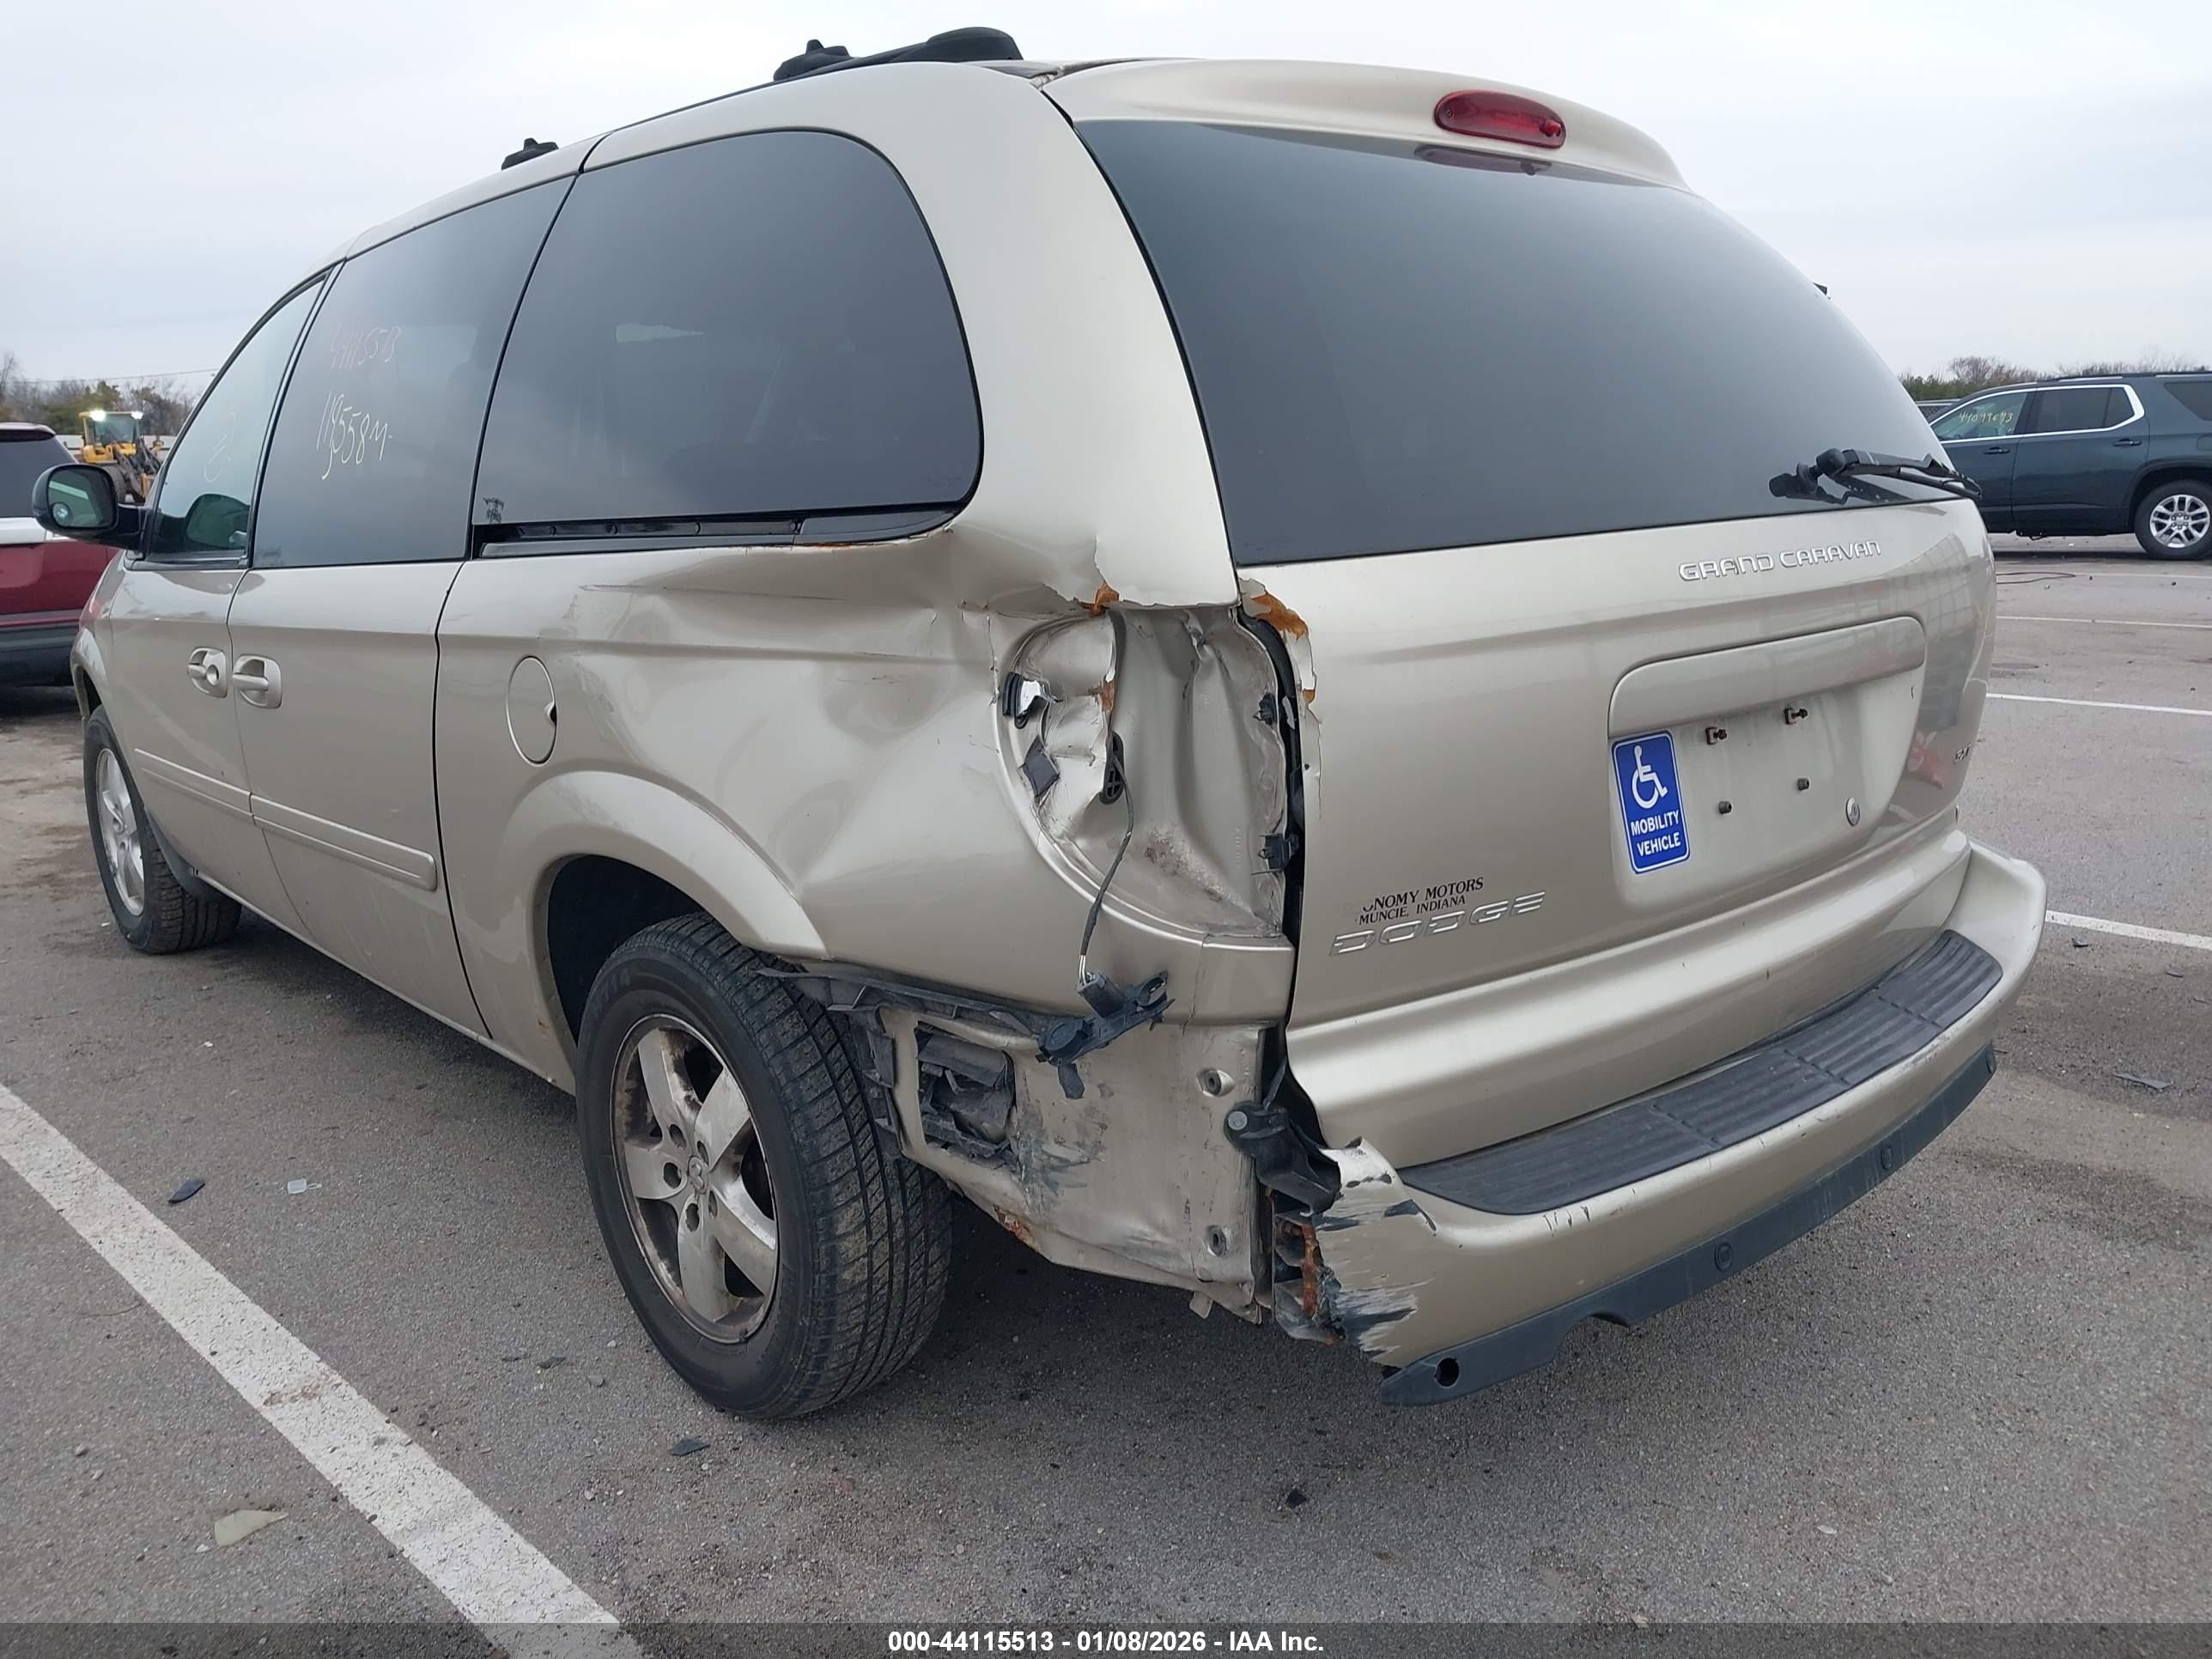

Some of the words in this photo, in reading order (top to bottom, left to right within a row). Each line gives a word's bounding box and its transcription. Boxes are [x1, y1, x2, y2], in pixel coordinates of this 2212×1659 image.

[1678, 554, 1775, 581] GRAND
[1779, 540, 1881, 568] CARAVAN
[1630, 810, 1680, 836] MOBILITY
[1637, 832, 1681, 857] VEHICLE
[1425, 877, 1485, 901] MOTORS
[1416, 895, 1466, 915] INDIANA
[1329, 890, 1546, 956] DODGE
